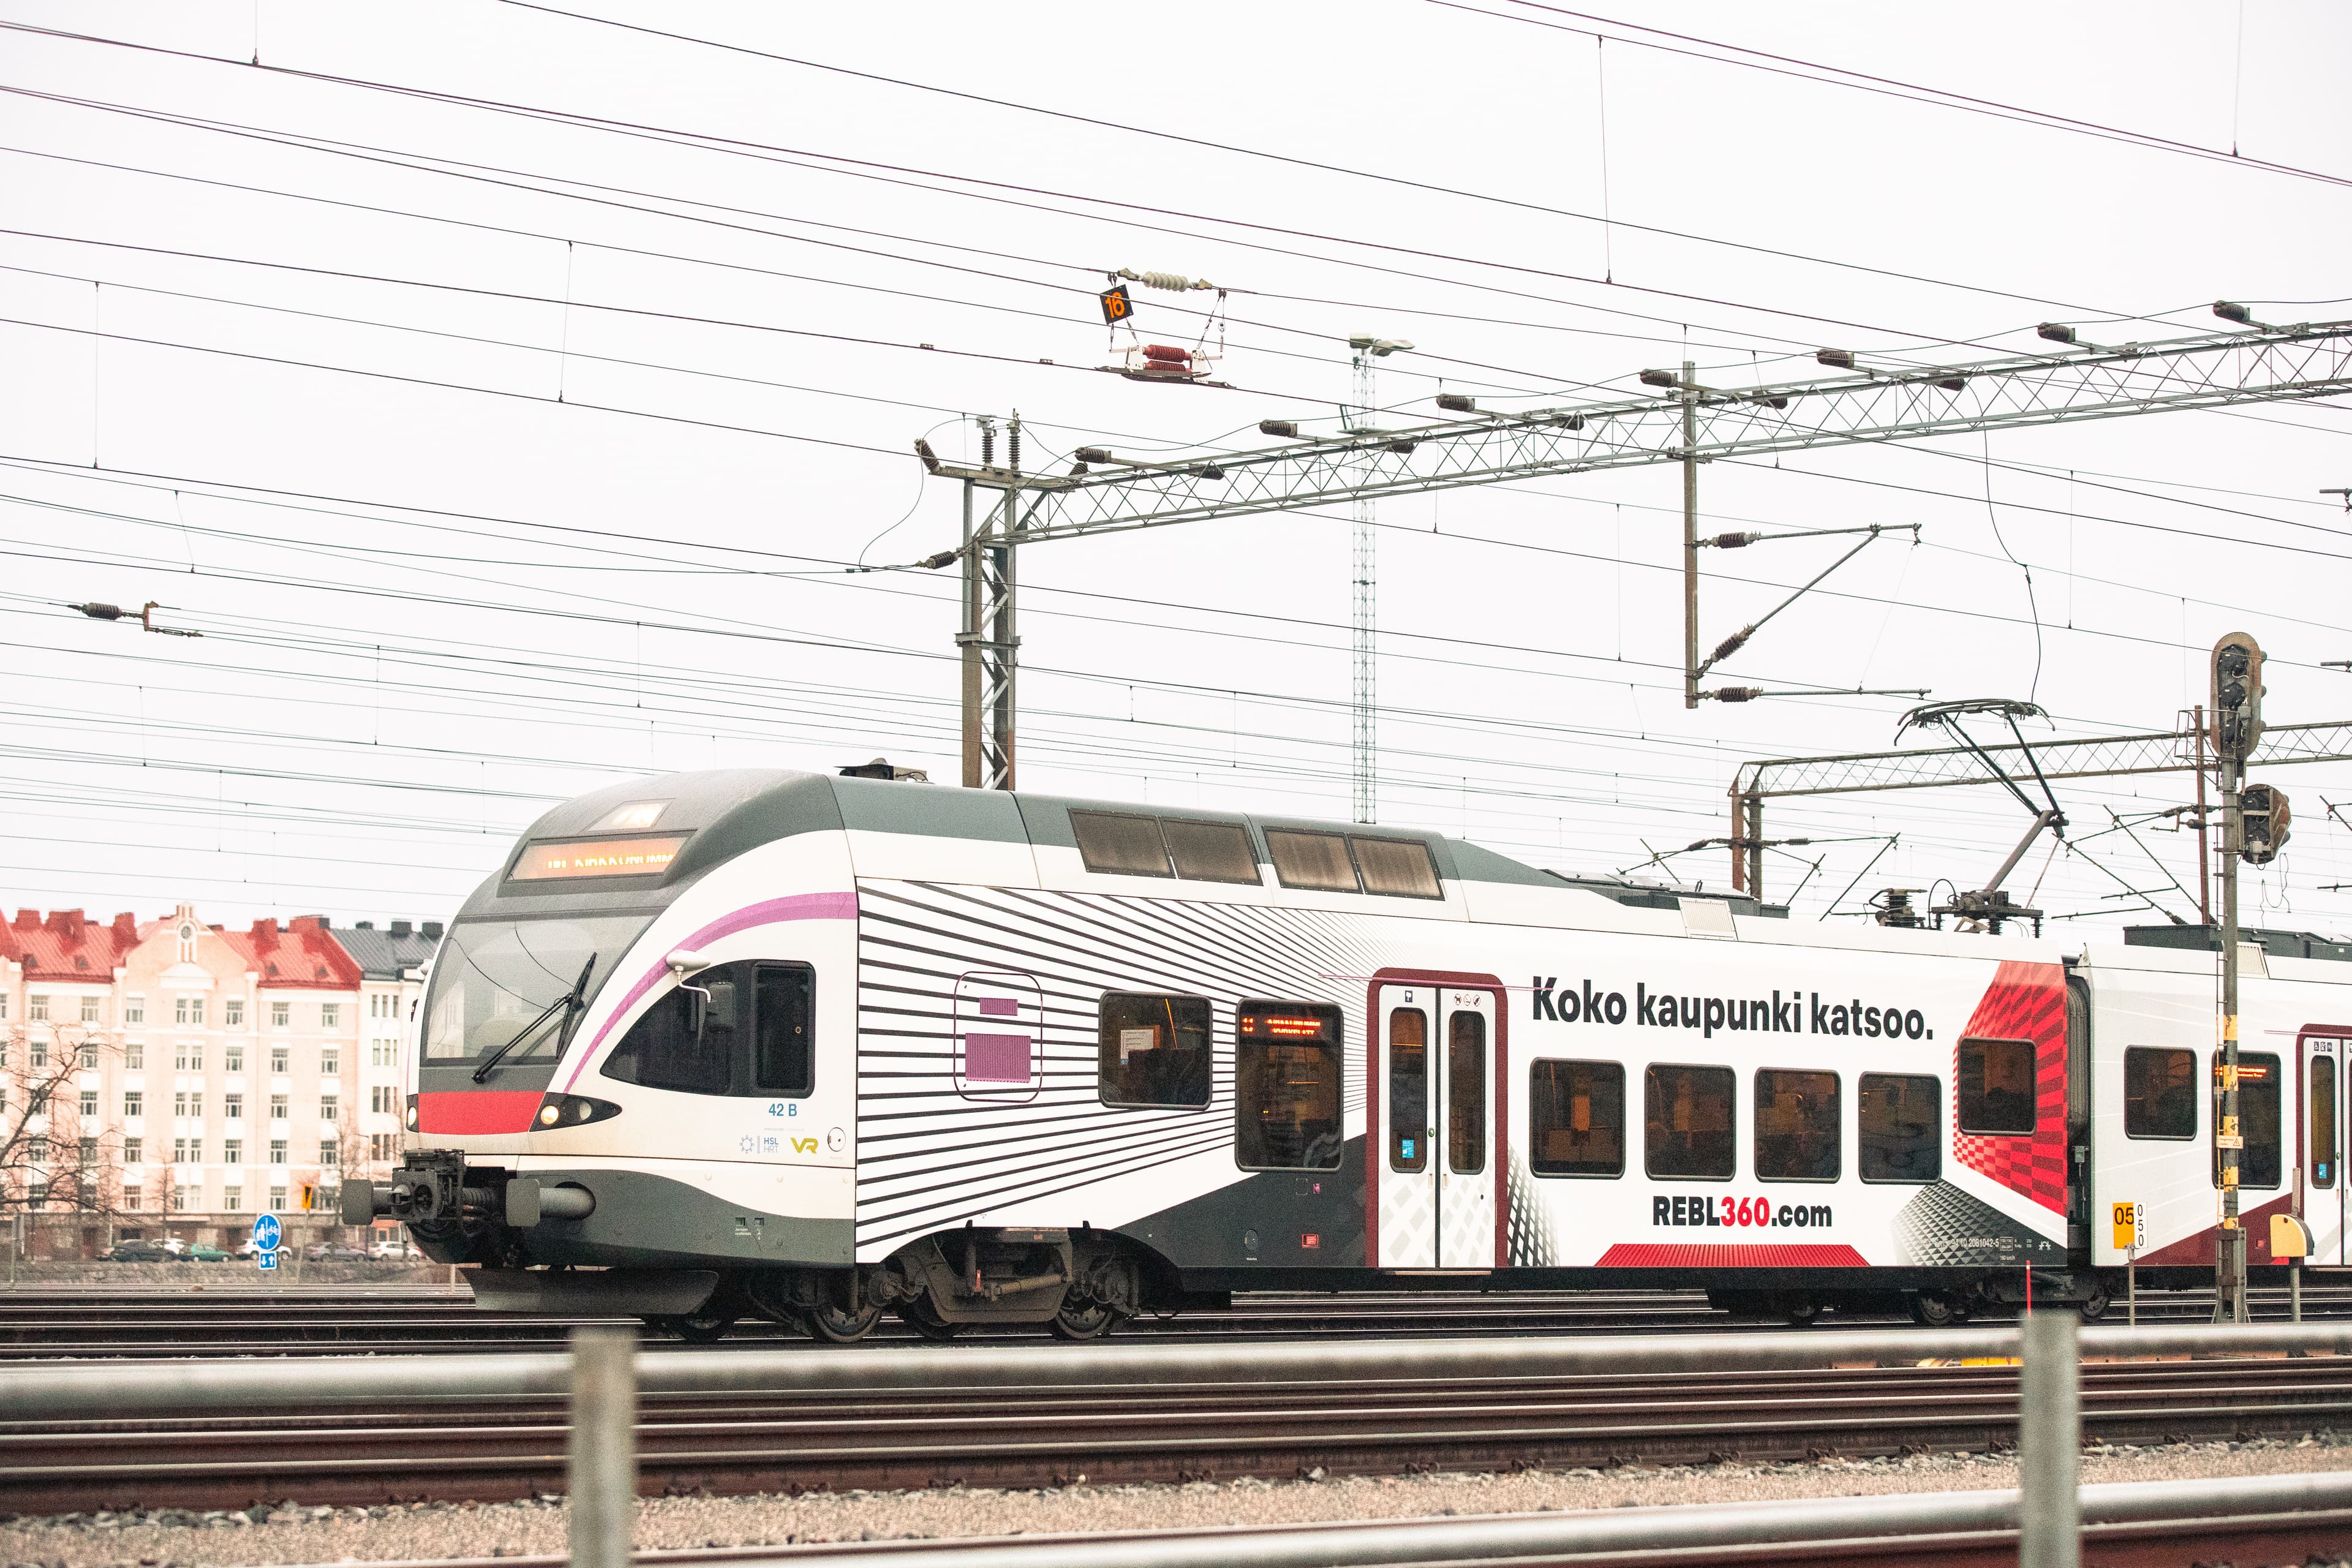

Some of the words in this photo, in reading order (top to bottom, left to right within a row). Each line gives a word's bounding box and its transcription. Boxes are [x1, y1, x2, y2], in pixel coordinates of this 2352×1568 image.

[1105, 291, 1125, 318] 16
[1533, 976, 1627, 1025] Koko
[1637, 982, 1801, 1039] kaupunki
[1811, 992, 1933, 1040] katsoo.
[769, 1104, 784, 1117] 42
[789, 1104, 797, 1117] B
[791, 1137, 819, 1154] VR
[1653, 1196, 1832, 1227] REBL360.com
[2114, 1207, 2135, 1225] 05
[1968, 1238, 2000, 1247] 2081042-5
